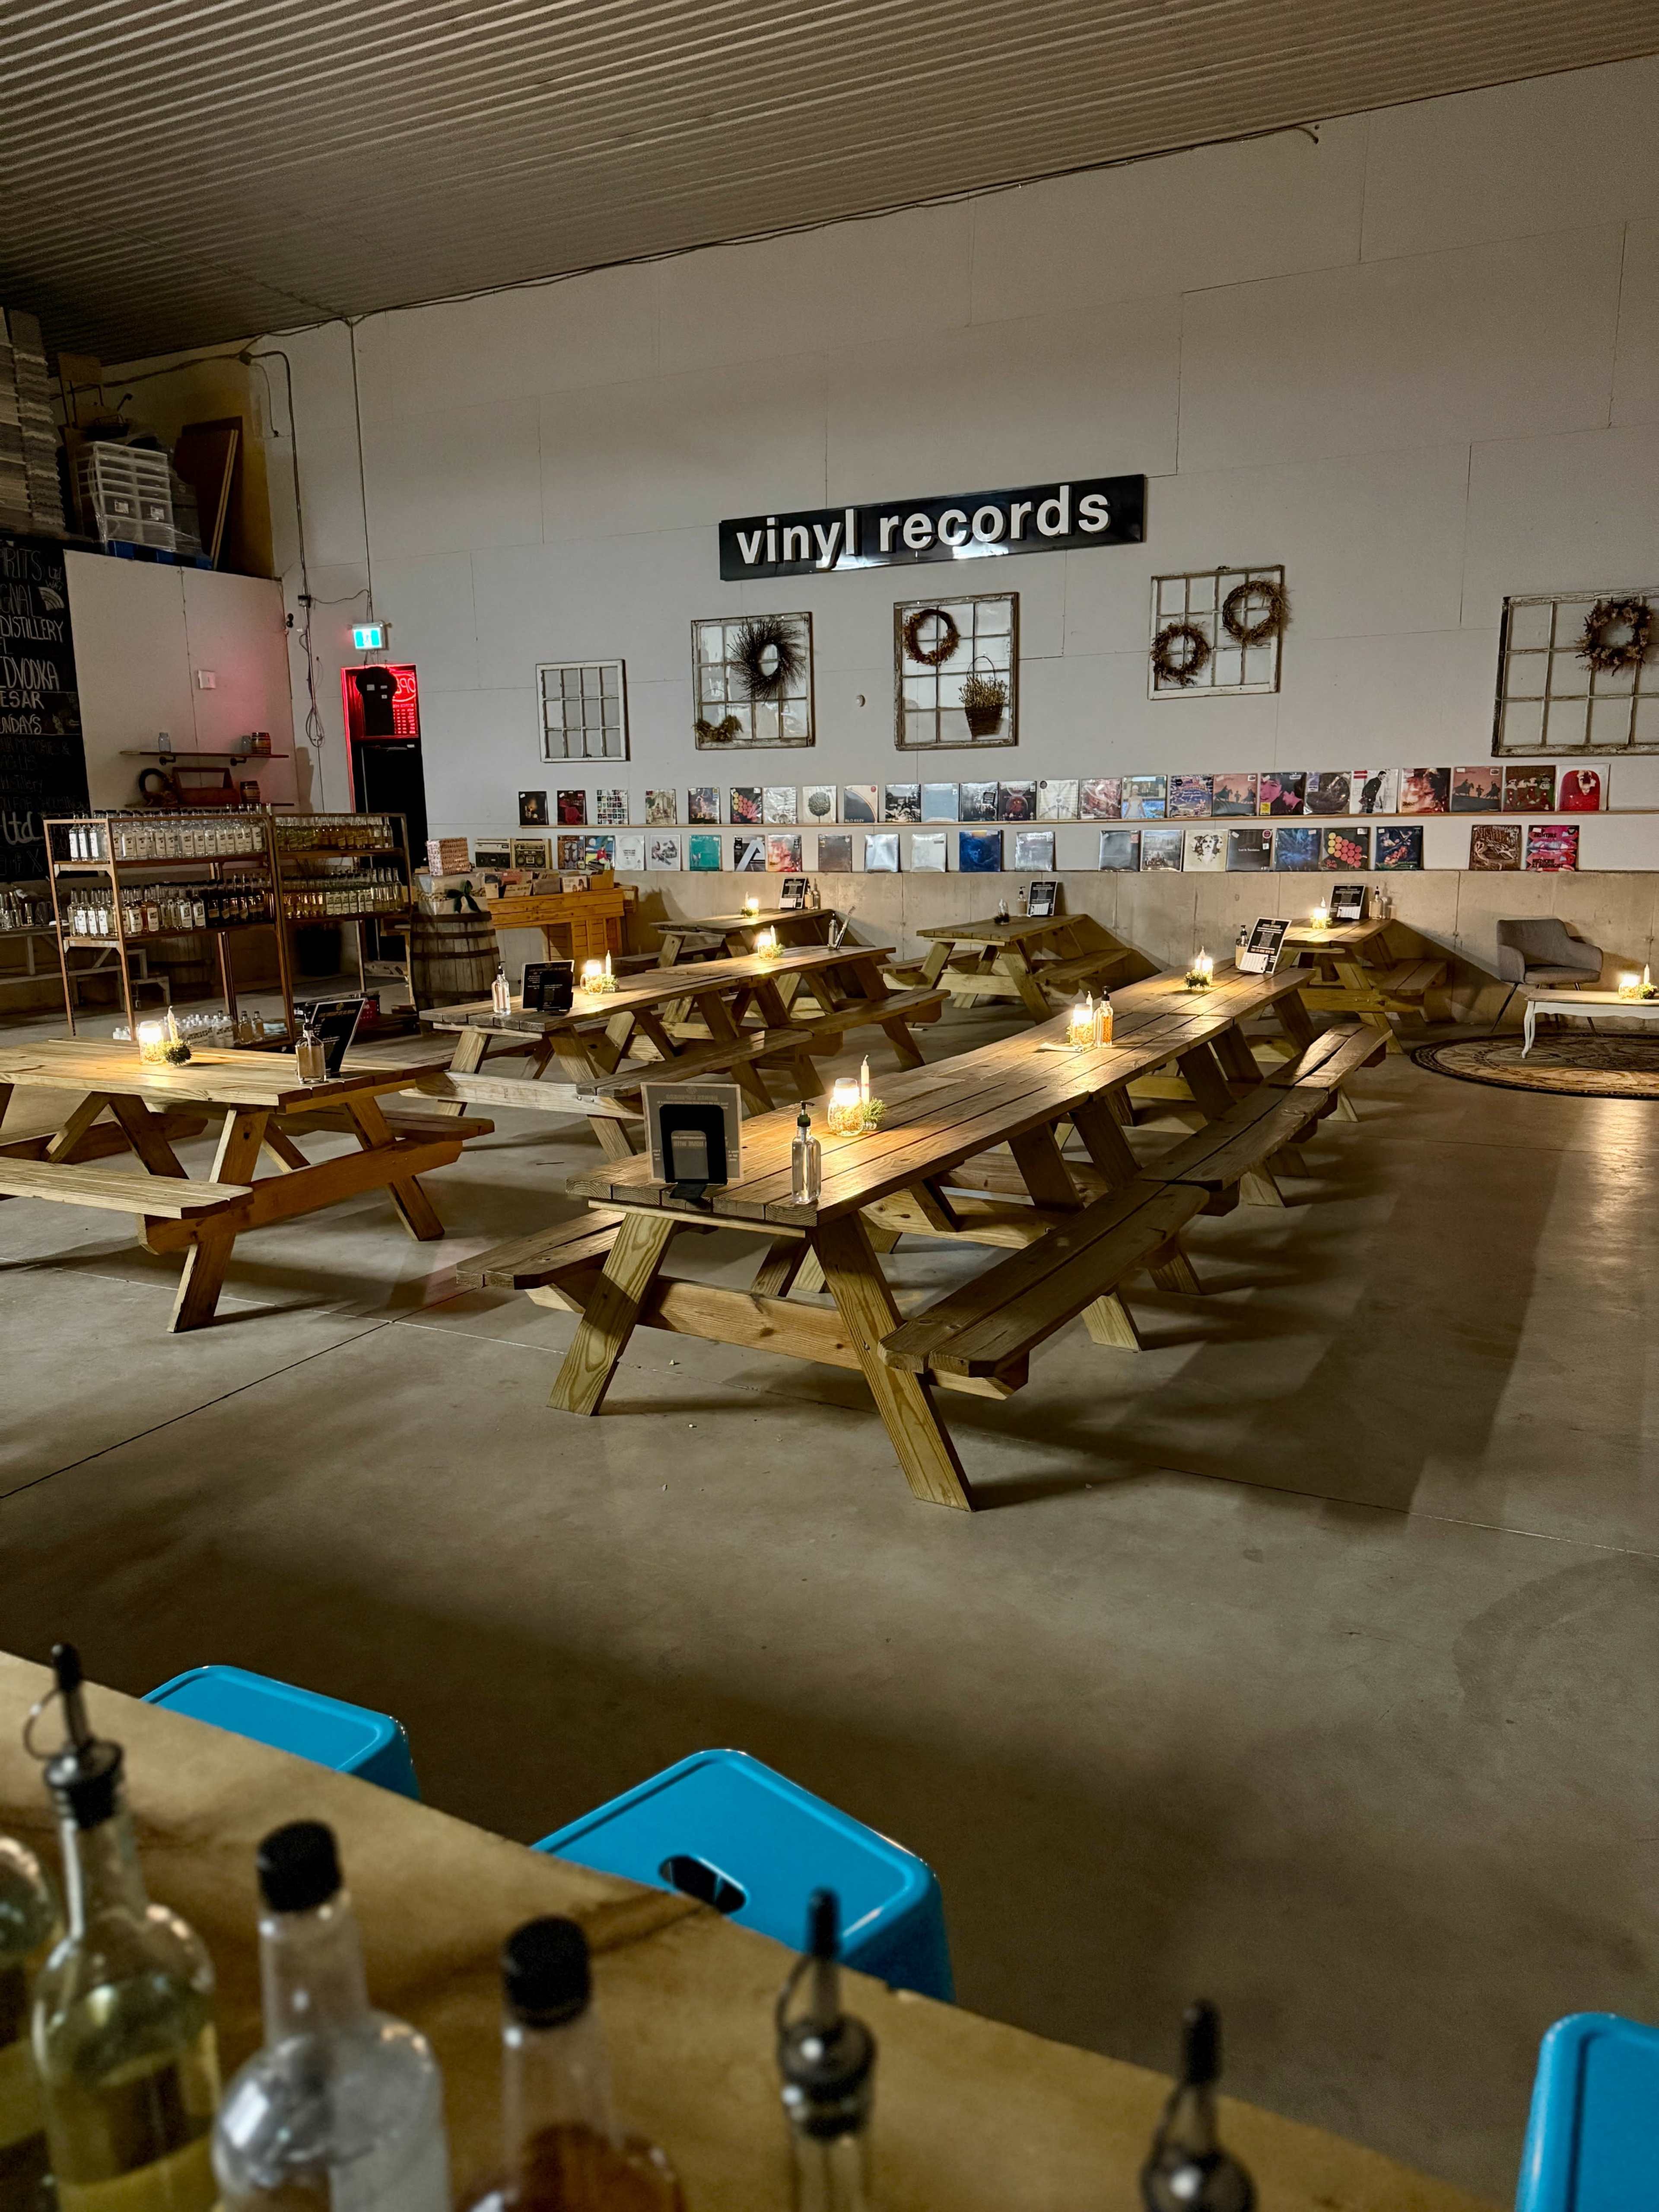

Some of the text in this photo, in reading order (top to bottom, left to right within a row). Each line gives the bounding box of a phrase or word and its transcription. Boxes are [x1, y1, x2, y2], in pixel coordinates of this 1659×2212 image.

[736, 485, 1111, 570] vinyl records
[0, 690, 45, 710] ESAR
[0, 713, 42, 735] UNDAYS
